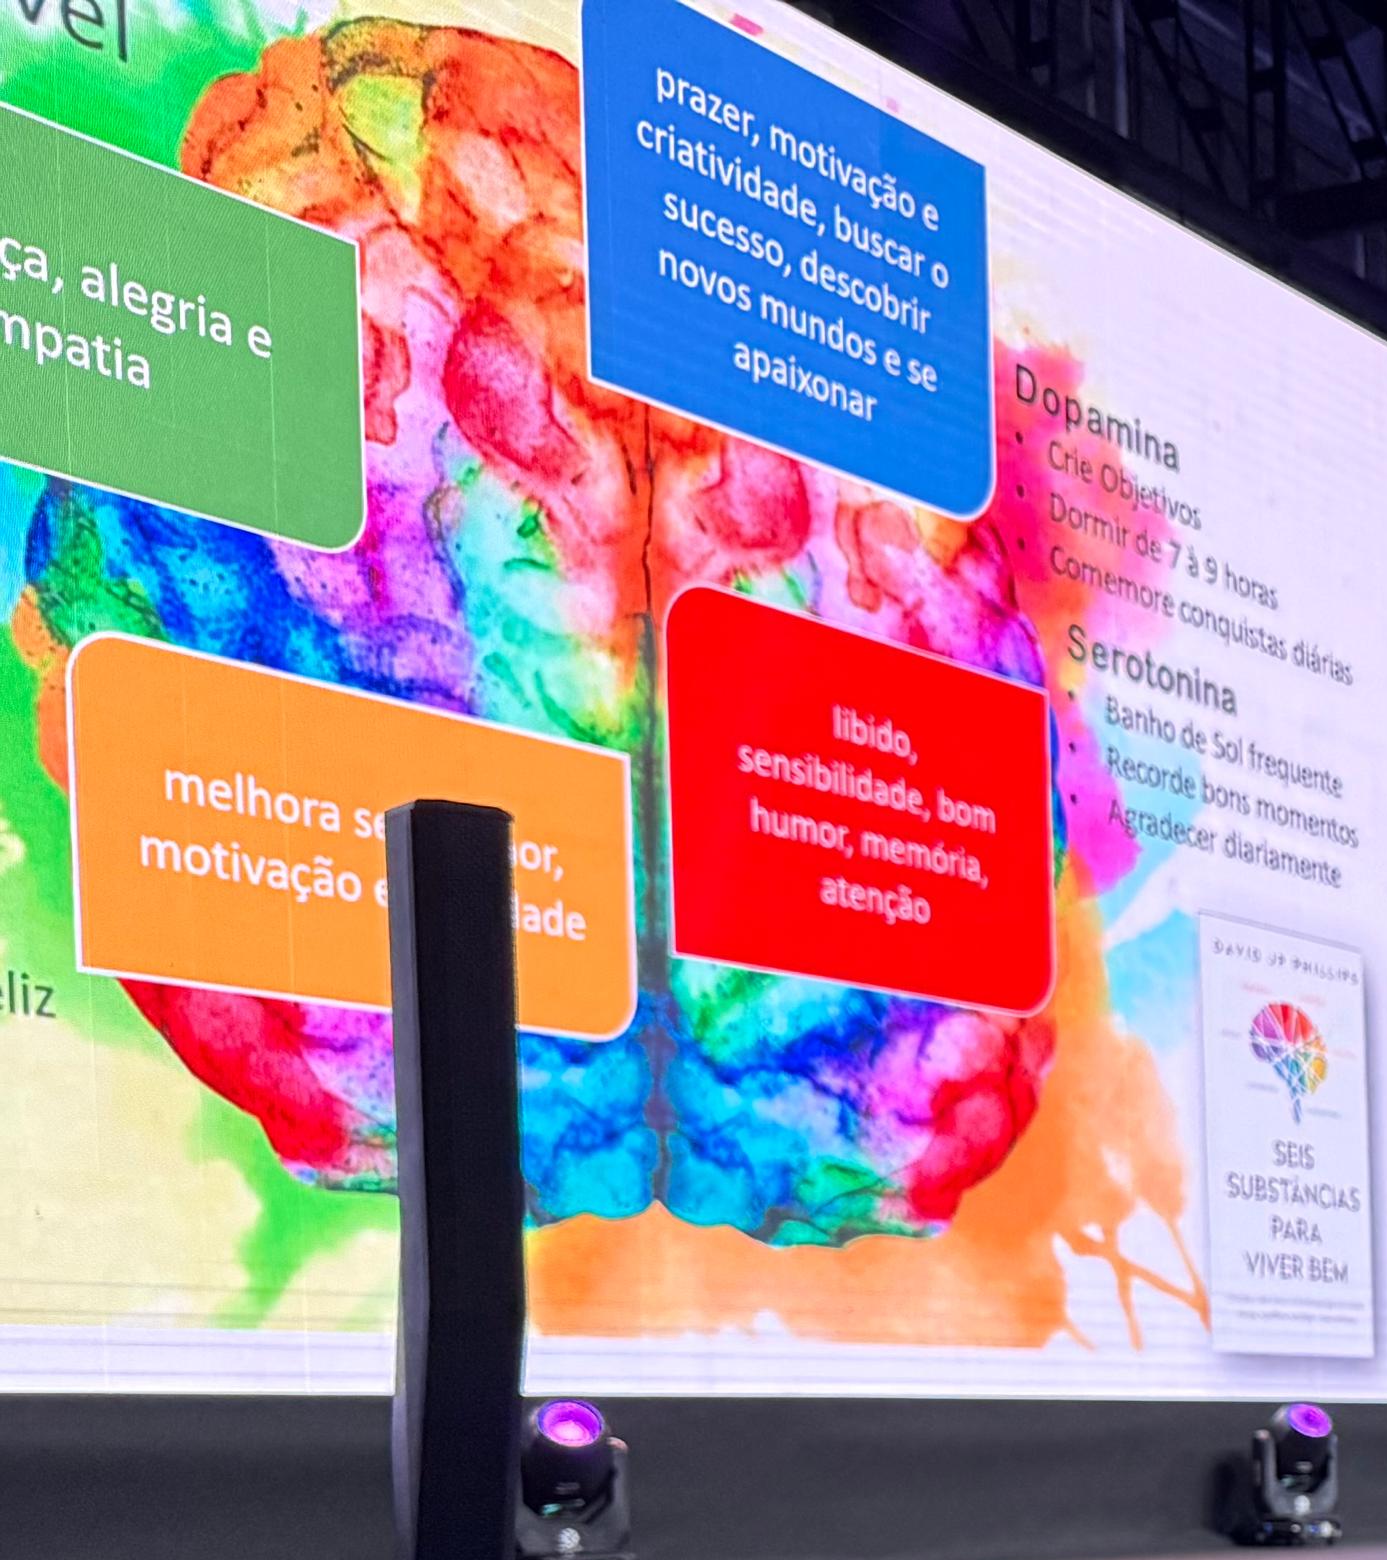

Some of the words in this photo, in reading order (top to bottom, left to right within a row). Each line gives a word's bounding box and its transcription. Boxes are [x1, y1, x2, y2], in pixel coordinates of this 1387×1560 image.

[656, 66, 760, 147] prazer,
[769, 121, 915, 219] motivação
[922, 201, 940, 232] e
[636, 117, 826, 237] criatividade,
[834, 205, 926, 277] buscar
[931, 262, 950, 290] o
[0, 237, 64, 294] ça,
[81, 262, 232, 346] alegria
[248, 325, 272, 358] e
[663, 191, 792, 277] sucesso,
[800, 249, 931, 335] descobrir
[0, 309, 150, 389] mpatia
[659, 248, 752, 312] novos
[760, 292, 877, 364] mundos
[884, 346, 901, 374] e
[907, 359, 938, 392] se
[733, 340, 878, 422] apaixonar
[1015, 363, 1180, 472] Dopamina
[1048, 440, 1093, 483] Crie
[1101, 463, 1202, 530] Objetivos
[1050, 492, 1129, 546] Dormir
[1135, 522, 1162, 561] de
[1168, 539, 1182, 569] 7
[1205, 556, 1218, 586] 9
[1224, 562, 1278, 611] horas
[1049, 545, 1175, 616] Comemore
[1179, 601, 1288, 661] conquistas
[1293, 639, 1353, 687] diárias
[1066, 623, 1238, 716] Serotonina
[832, 703, 919, 766] libido,
[1105, 694, 1176, 741] Banho
[1181, 718, 1208, 752] de
[1212, 729, 1244, 766] Sol
[1248, 742, 1344, 799] frequente
[165, 768, 340, 834] melhora
[354, 807, 385, 840] se
[510, 840, 564, 882] or,
[737, 744, 931, 823] sensibilidade,
[936, 787, 997, 834] bom
[1107, 745, 1197, 798] Recorde
[1201, 776, 1251, 815] bons
[1256, 795, 1359, 850] momentos
[139, 831, 363, 904] motivação
[749, 796, 854, 859] humor,
[860, 828, 990, 890] memória,
[1108, 797, 1218, 852] Agradecer
[1224, 829, 1342, 889] diariamente
[819, 874, 932, 926] atenção
[0, 969, 57, 1018] liz
[1273, 1139, 1315, 1170] SEIS
[1244, 1251, 1304, 1280] VIVER
[1308, 1256, 1349, 1283] BEM
[1272, 1214, 1323, 1243] PARA
